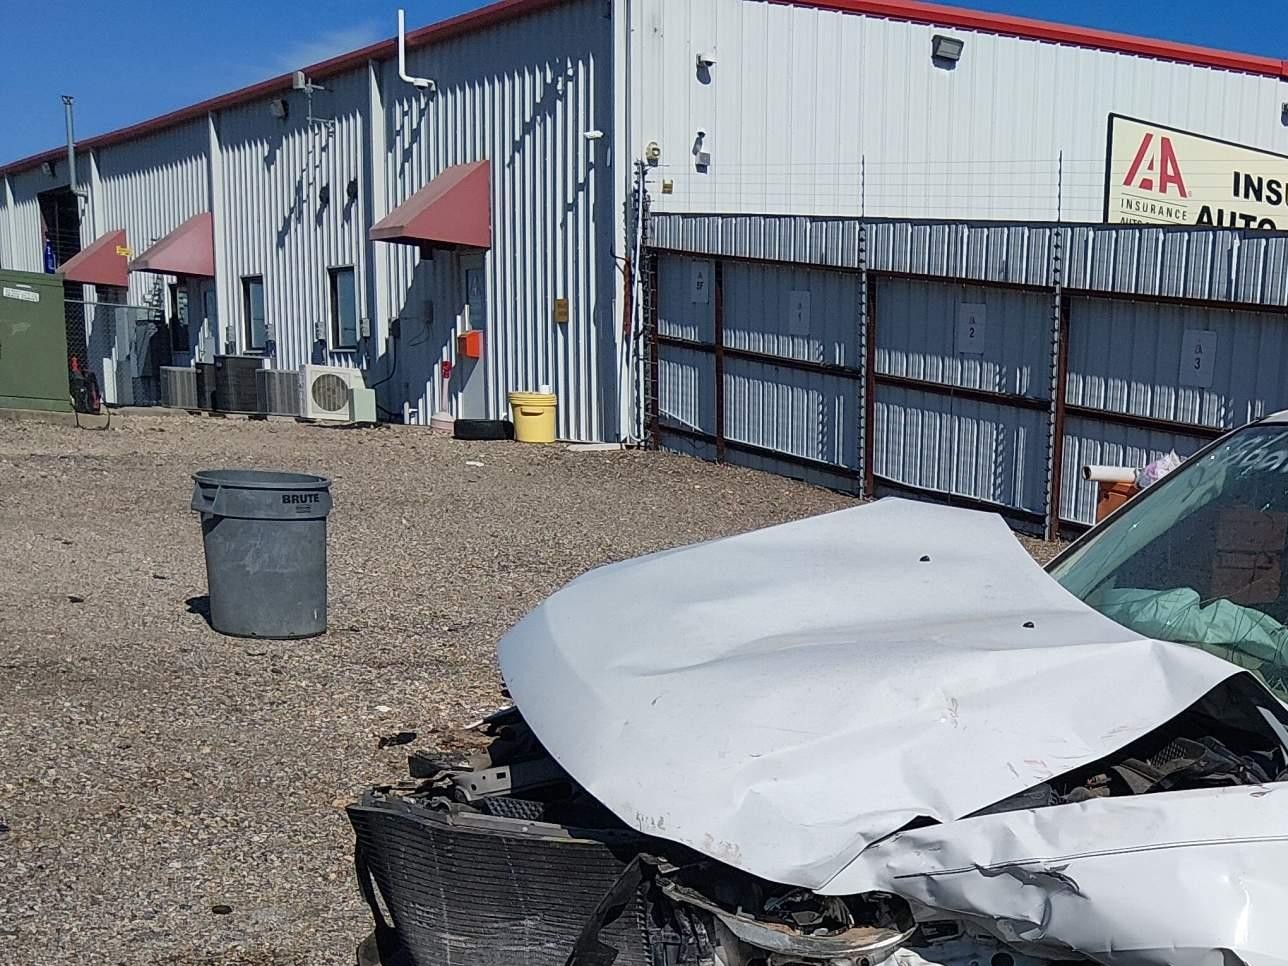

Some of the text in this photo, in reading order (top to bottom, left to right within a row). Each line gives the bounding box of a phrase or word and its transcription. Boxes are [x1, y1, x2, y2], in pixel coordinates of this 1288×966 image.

[1120, 198, 1188, 221] INSURANCE
[969, 327, 975, 338] 2
[1194, 357, 1201, 370] 3
[281, 493, 320, 504] BRUTE
